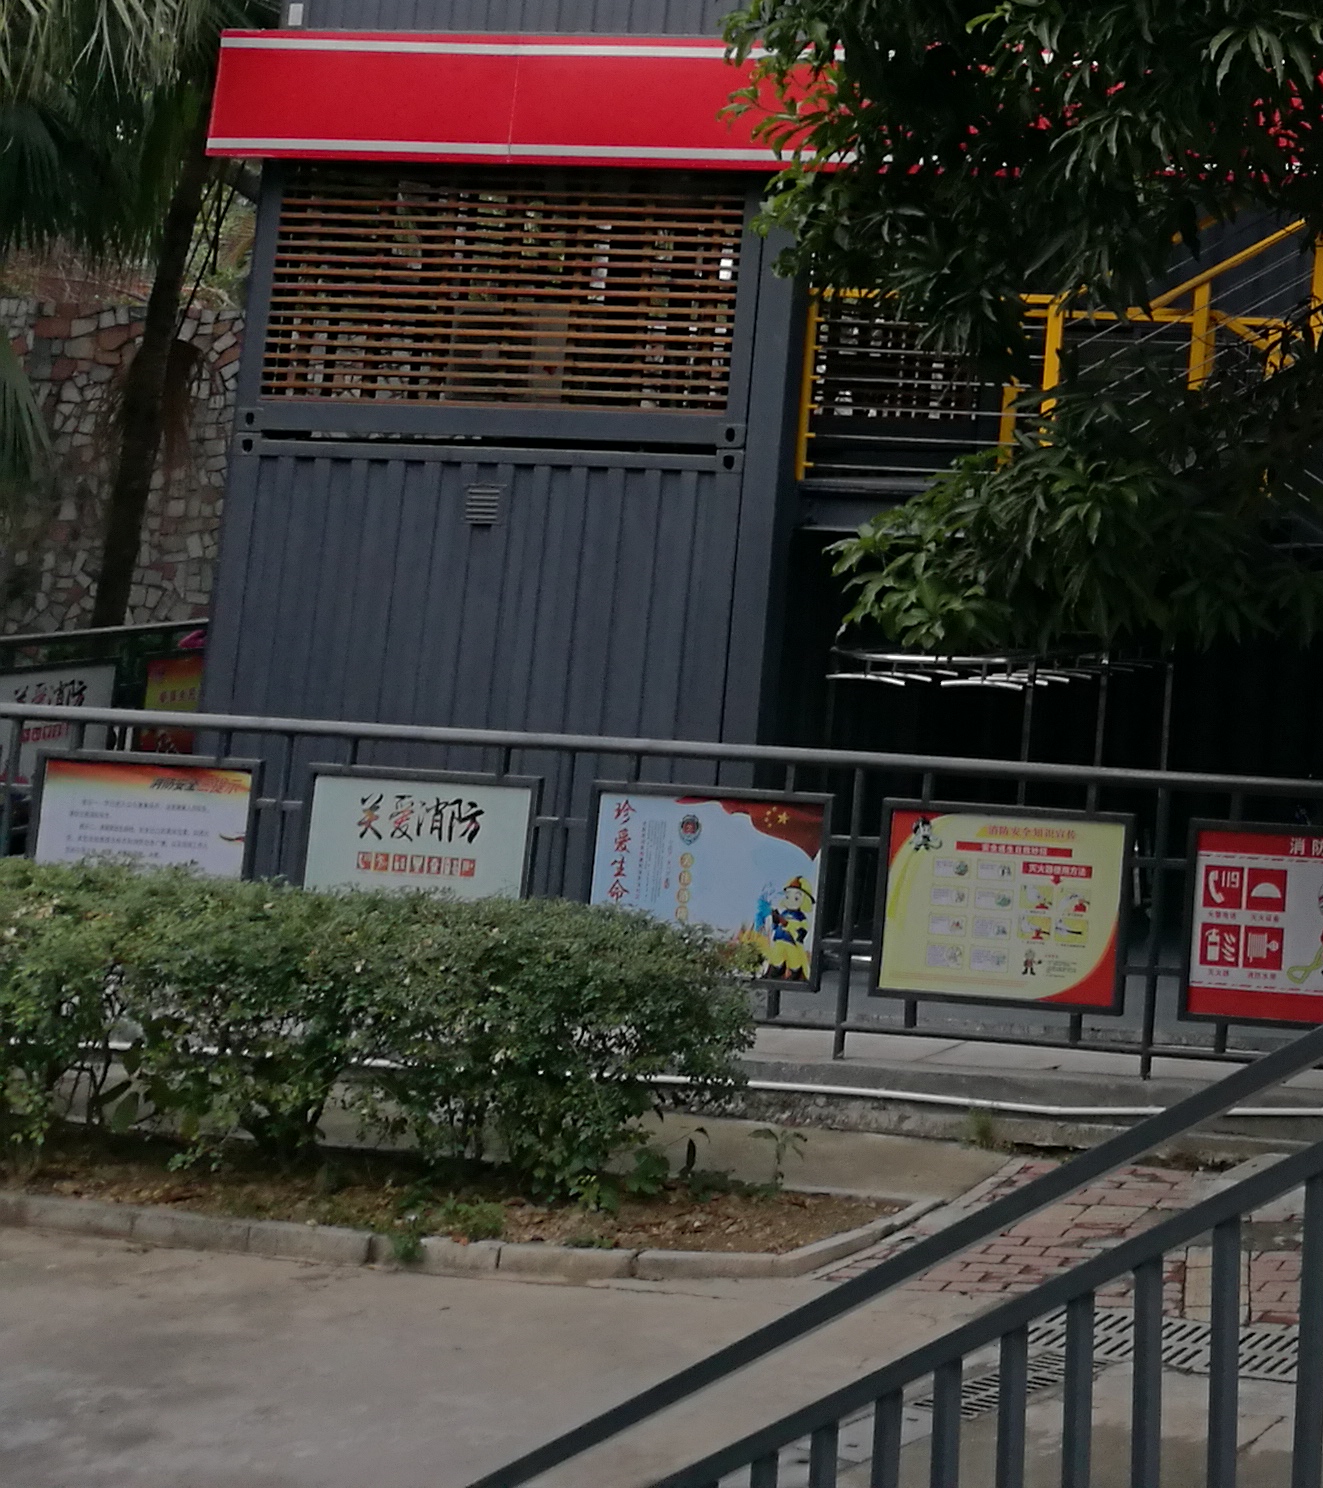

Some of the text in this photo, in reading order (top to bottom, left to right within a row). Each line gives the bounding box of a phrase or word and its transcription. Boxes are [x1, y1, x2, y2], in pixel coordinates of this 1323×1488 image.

[357, 793, 484, 844] 关爱消防
[608, 799, 636, 902] 珍爱生命
[1221, 871, 1240, 888] 119
